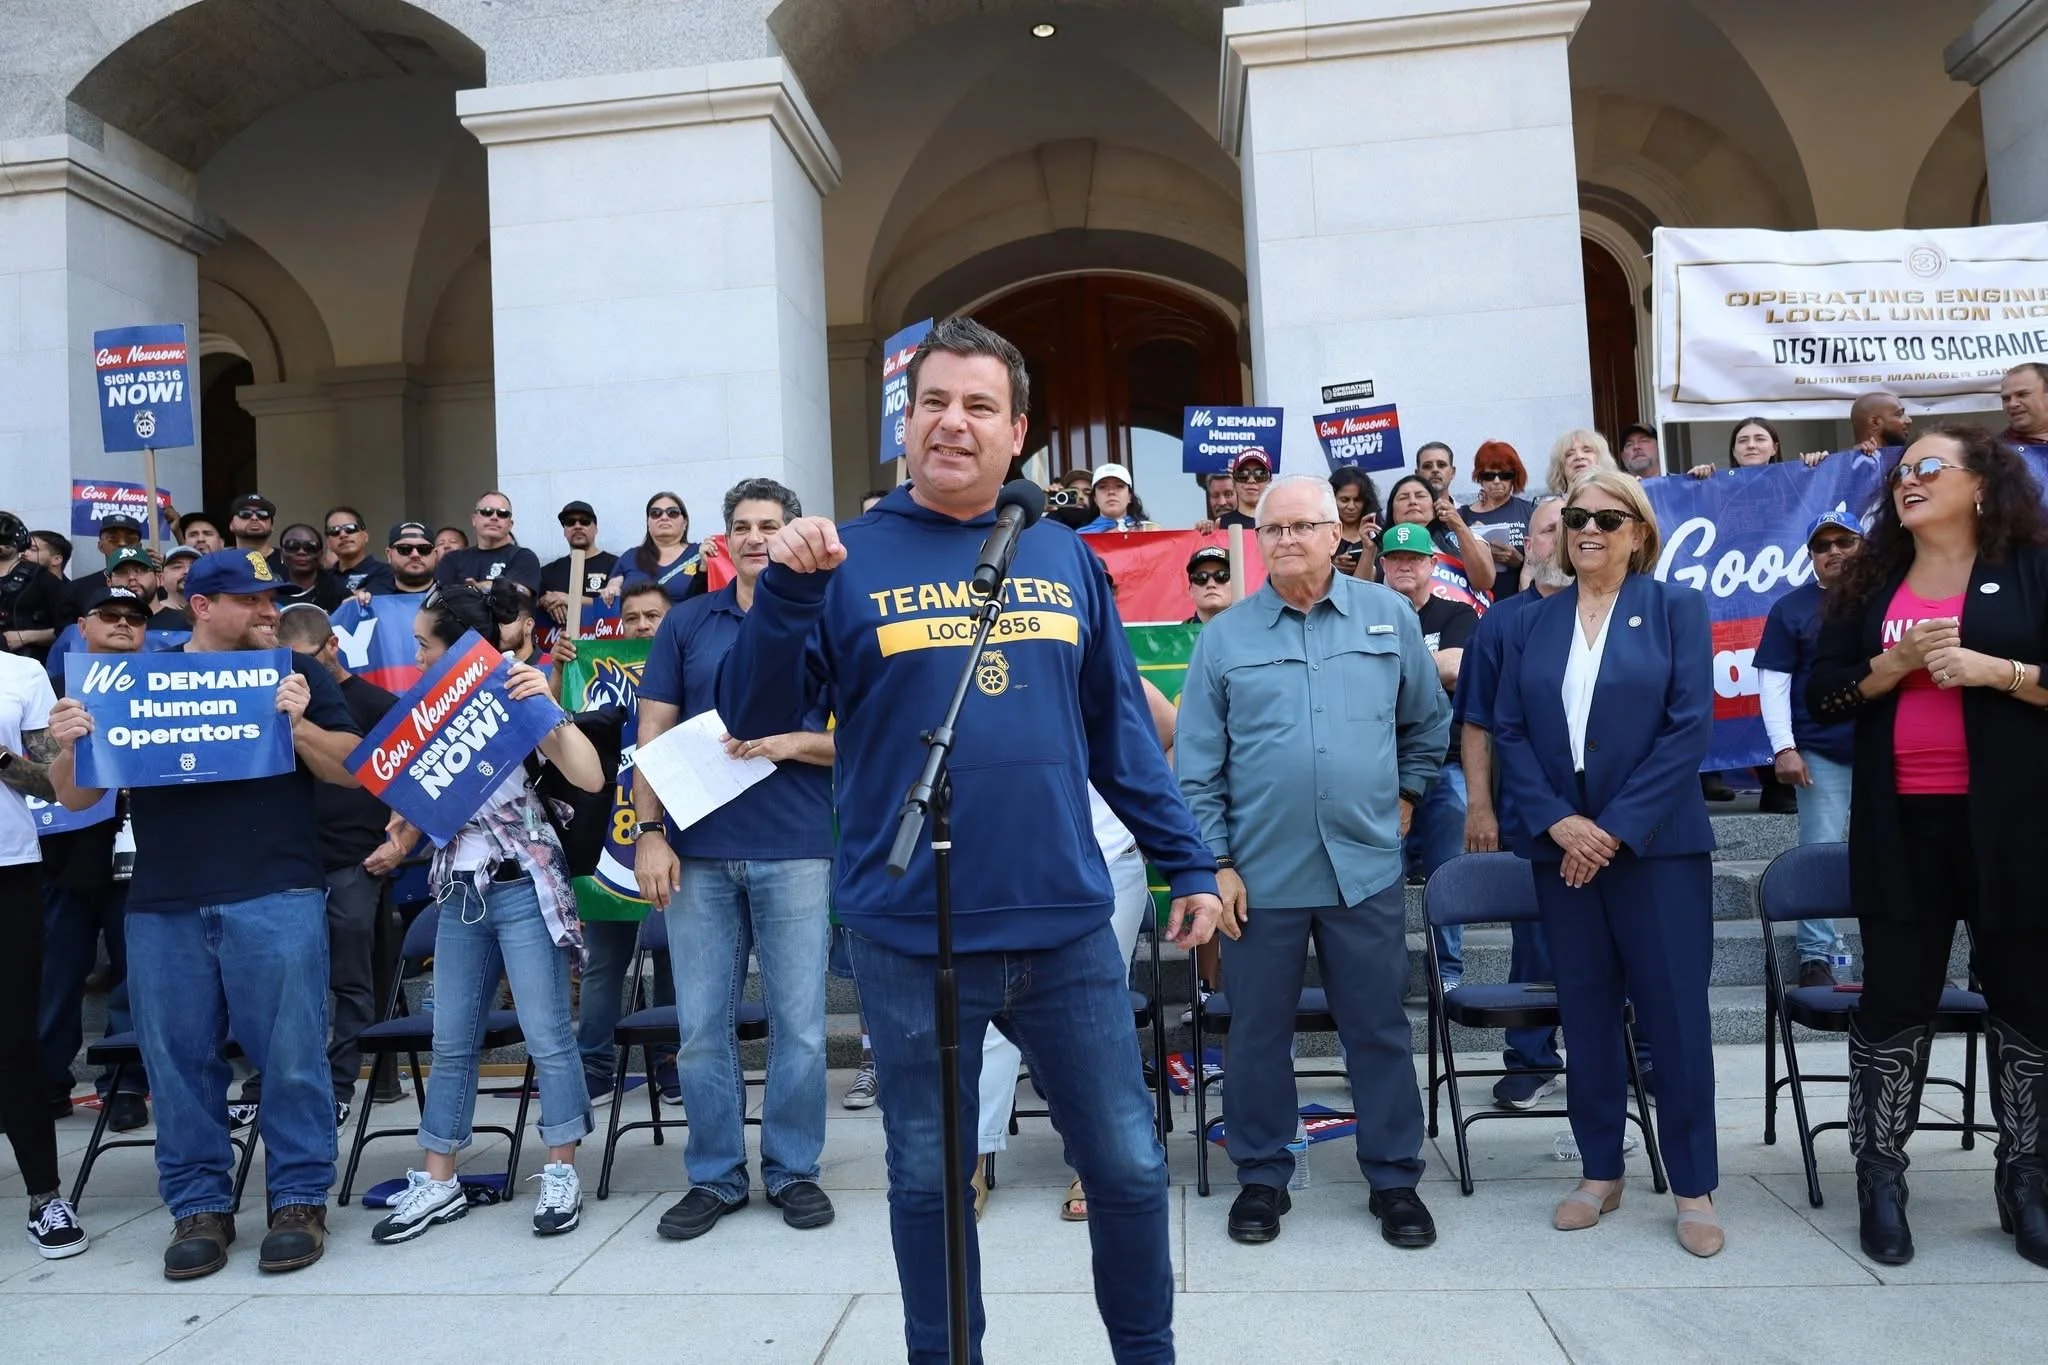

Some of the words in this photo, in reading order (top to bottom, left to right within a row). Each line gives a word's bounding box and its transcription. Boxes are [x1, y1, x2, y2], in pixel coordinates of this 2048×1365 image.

[1724, 287, 1925, 307] OPERATING
[1766, 307, 1880, 324] LOCAL
[1889, 306, 1990, 321] UNION
[97, 348, 121, 366] Gov.
[126, 345, 185, 364] Newsom:
[1773, 336, 1887, 364] DISTRICT
[1894, 336, 1926, 361] 80
[104, 373, 134, 386] SIGN
[138, 370, 181, 382] AB316
[885, 378, 900, 395] SIGN
[1794, 374, 1882, 384] BUSINESS
[1887, 370, 1972, 382] MANAGER
[108, 381, 183, 407] NOW!
[1190, 409, 1213, 427] We
[1217, 416, 1277, 427] DEMAND
[1341, 417, 1391, 435] Newsom:
[1208, 429, 1256, 440] Human
[1329, 437, 1349, 447] SIGN
[1350, 432, 1383, 444] AB316
[1330, 439, 1383, 459] NOW!
[92, 502, 120, 511] SIGN
[121, 503, 148, 513] AB31
[999, 617, 1041, 635] 856
[82, 660, 136, 694] We
[149, 668, 279, 692] DEMAND
[130, 698, 237, 719] Human
[371, 740, 415, 782] Gov.
[411, 655, 489, 741] Newsom:
[108, 722, 260, 749] Operators
[409, 741, 450, 780] SIGN
[444, 689, 494, 744] AB316
[418, 698, 510, 801] NOW!
